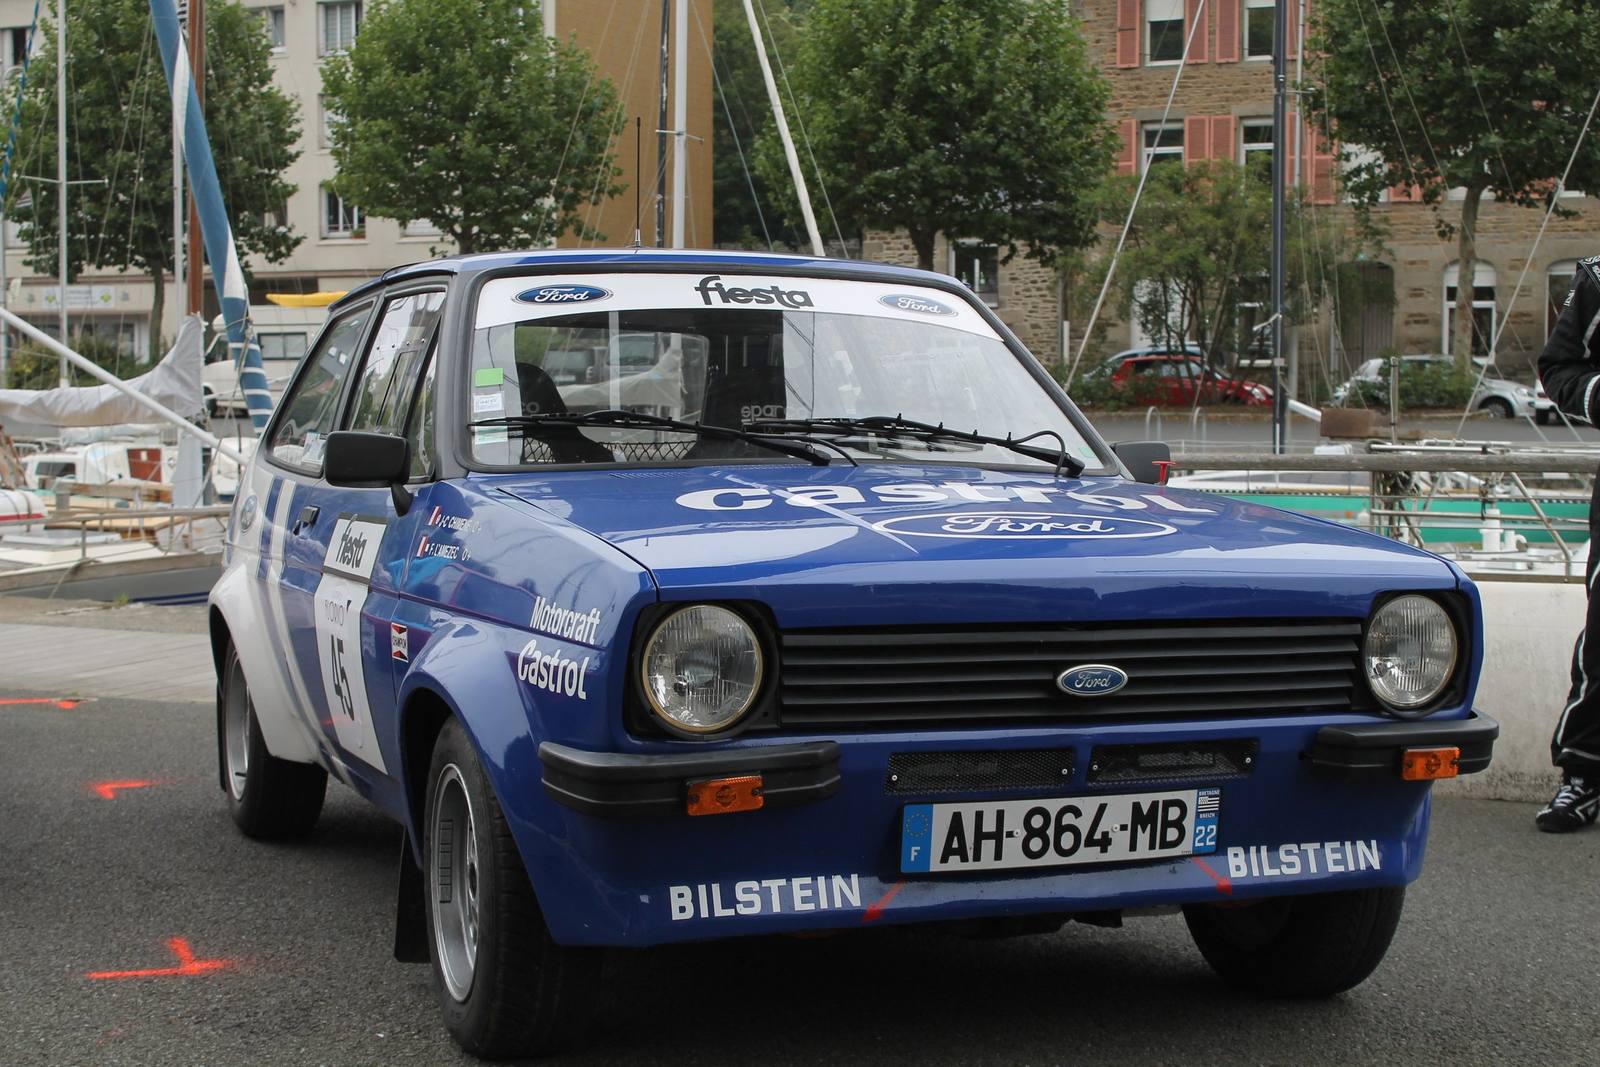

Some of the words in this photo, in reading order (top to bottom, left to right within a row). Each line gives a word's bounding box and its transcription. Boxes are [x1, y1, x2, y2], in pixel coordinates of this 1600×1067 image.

[534, 287, 589, 303] Ford
[695, 276, 814, 309] fiesta
[897, 297, 941, 313] Ford
[336, 513, 367, 568] fiesta
[941, 512, 1116, 534] Ford
[530, 596, 600, 645] Motorcraft
[331, 634, 354, 721] 45
[518, 640, 589, 700] Castrol
[1074, 669, 1112, 688] Ford
[910, 846, 921, 861] F
[939, 799, 1188, 864] AH-864-MB
[1195, 825, 1217, 847] 22
[1227, 840, 1380, 878] BILSTEIN
[670, 874, 861, 920] BILSTEIN
